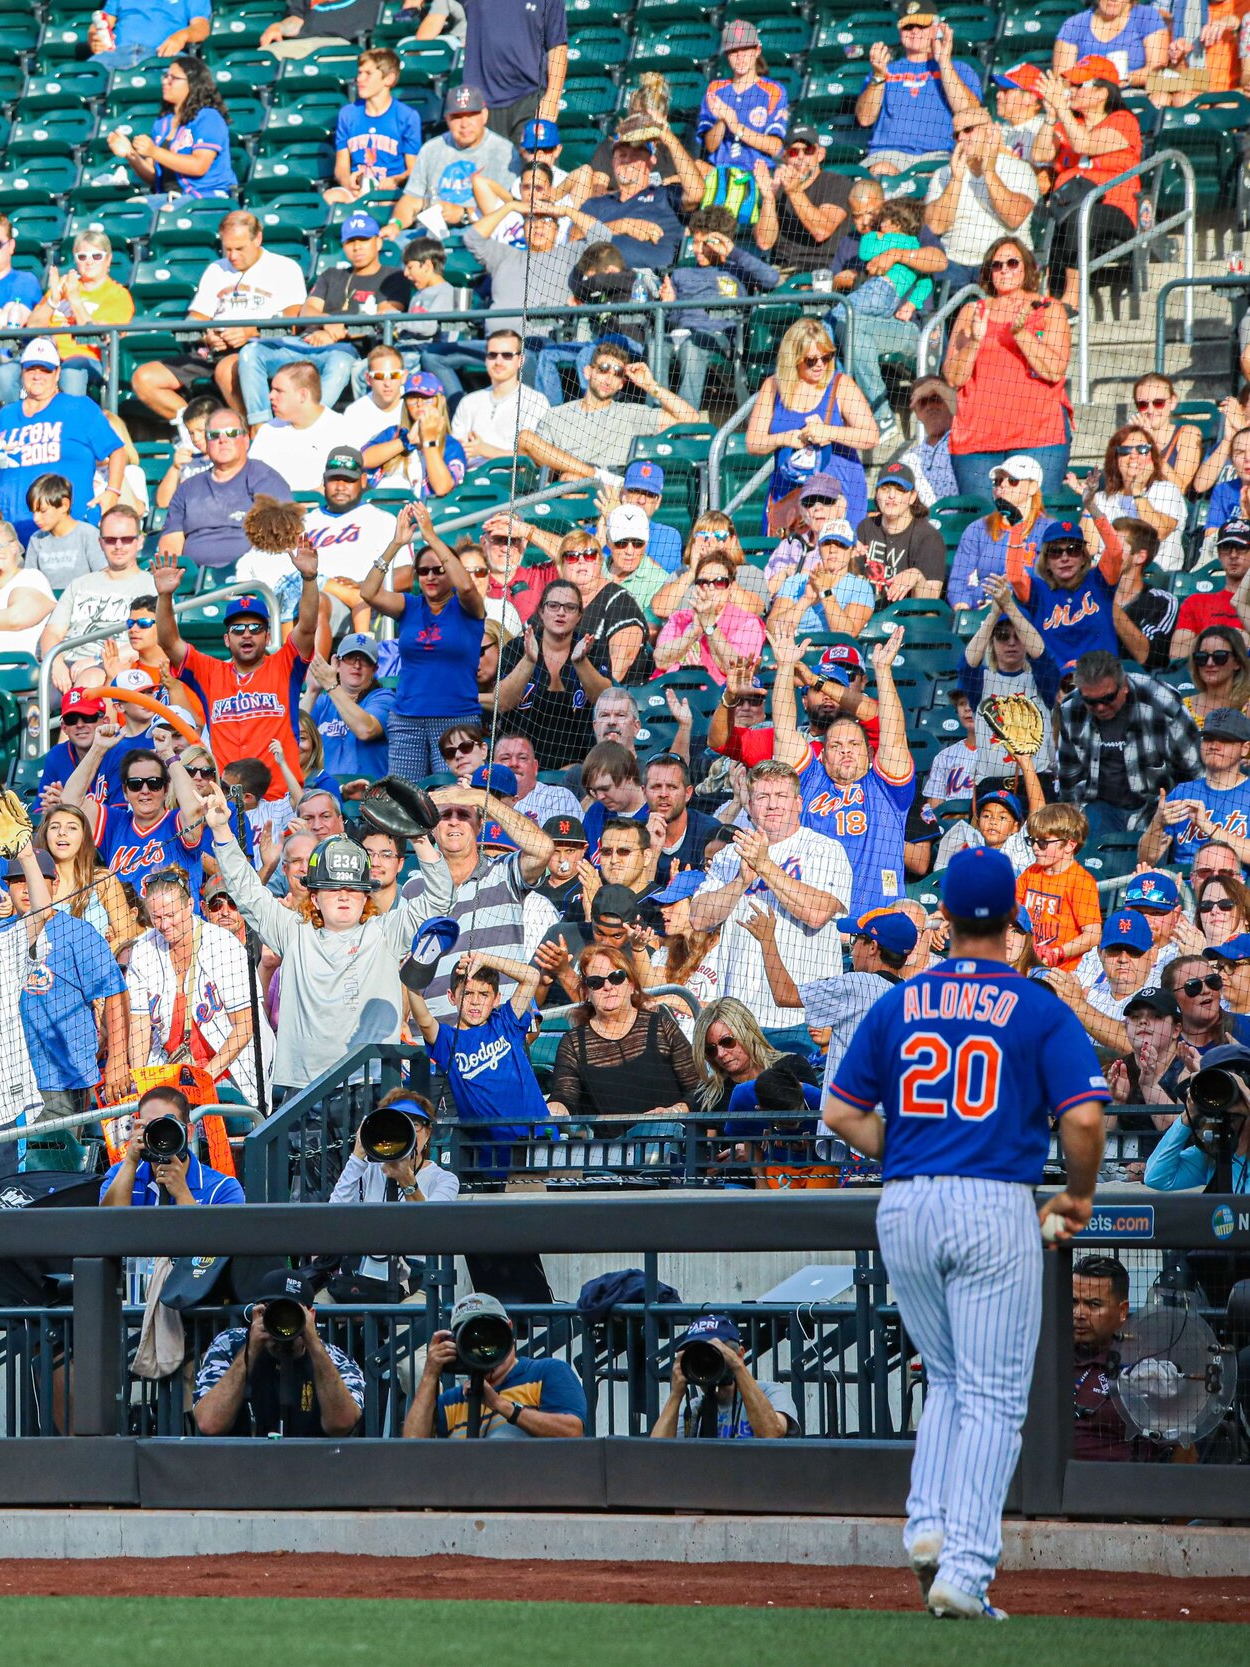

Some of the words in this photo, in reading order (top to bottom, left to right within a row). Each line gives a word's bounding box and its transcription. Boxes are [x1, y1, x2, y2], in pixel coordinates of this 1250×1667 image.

[21, 442, 62, 466] 2019
[835, 810, 866, 836] 18
[333, 854, 359, 870] 234
[903, 980, 1018, 1028] ALONSO
[900, 1032, 1002, 1121] 20
[1086, 1212, 1149, 1232] ets.com
